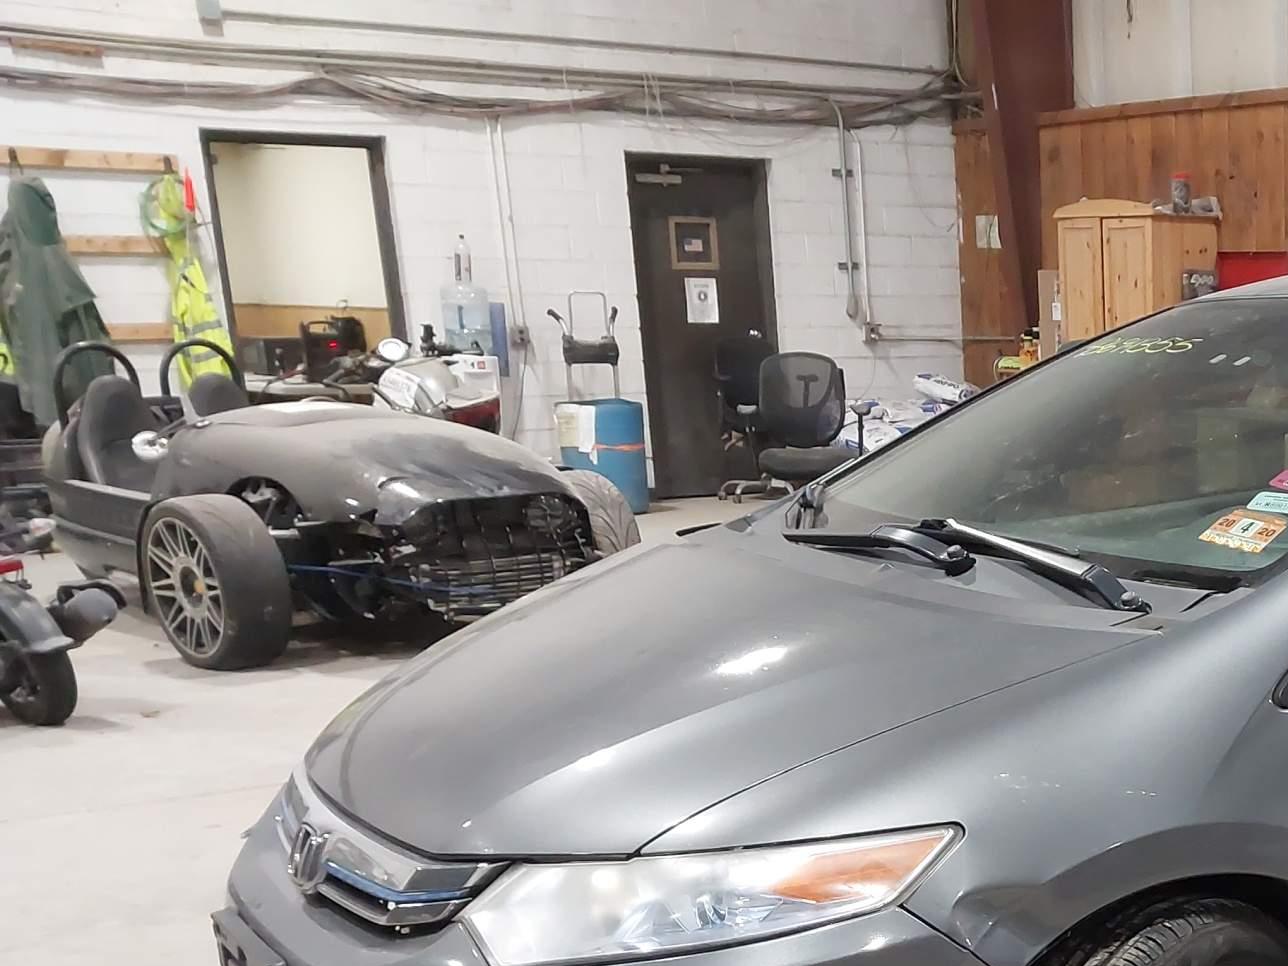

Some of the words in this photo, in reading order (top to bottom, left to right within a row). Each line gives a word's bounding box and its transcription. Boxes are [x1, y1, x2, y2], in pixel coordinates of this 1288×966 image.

[1217, 518, 1236, 529] 20
[1240, 521, 1253, 534] 4
[1257, 527, 1277, 538] 20
